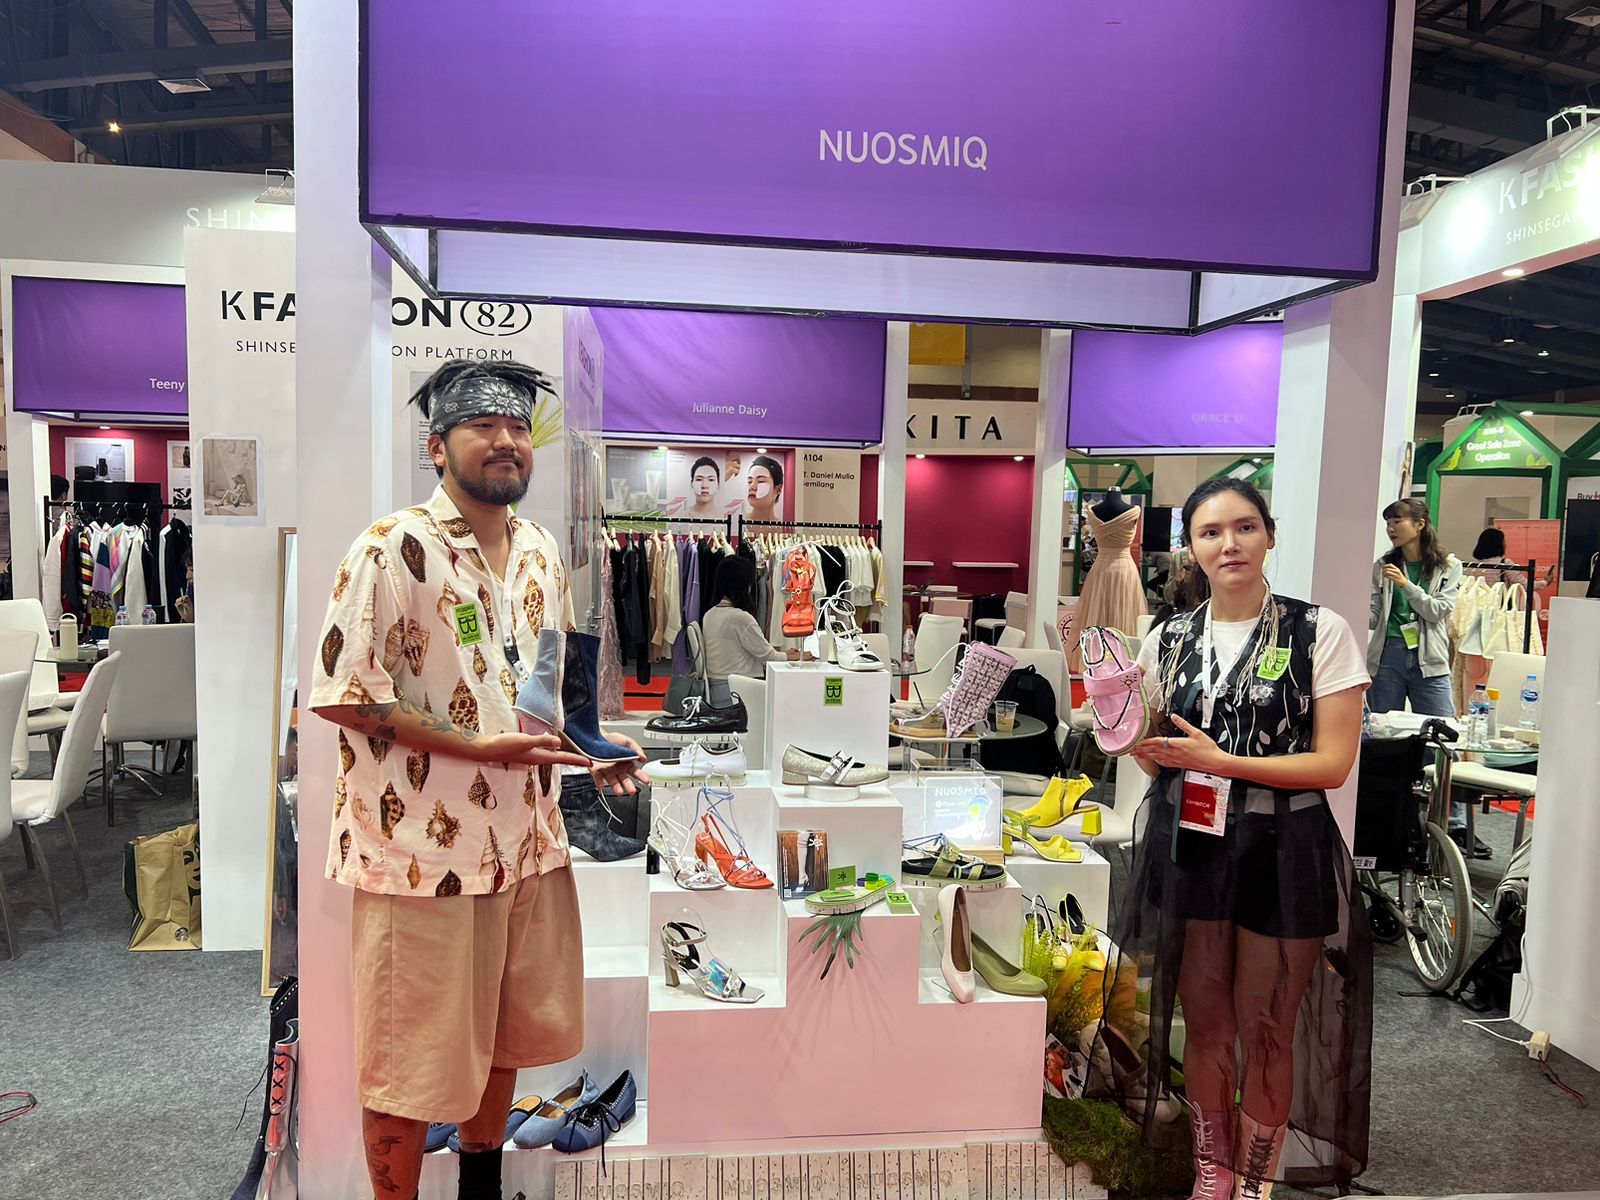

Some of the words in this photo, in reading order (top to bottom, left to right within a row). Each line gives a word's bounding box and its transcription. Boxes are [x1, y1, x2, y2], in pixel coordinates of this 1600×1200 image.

[819, 129, 988, 171] NUOSMIQ
[1499, 144, 1597, 215] KFAS
[477, 302, 515, 329] 82
[425, 346, 513, 361] PLATFORM
[149, 378, 185, 393] Teeny
[692, 402, 735, 414] Julianne
[738, 404, 768, 418] Daisy
[1466, 441, 1487, 451] Great
[1487, 440, 1503, 450] Sale
[1503, 439, 1521, 448] Zone
[1475, 452, 1511, 463] Operation
[810, 471, 834, 479] Daniel
[803, 481, 835, 490] emilang
[1186, 799, 1210, 809] EXHIBITOR
